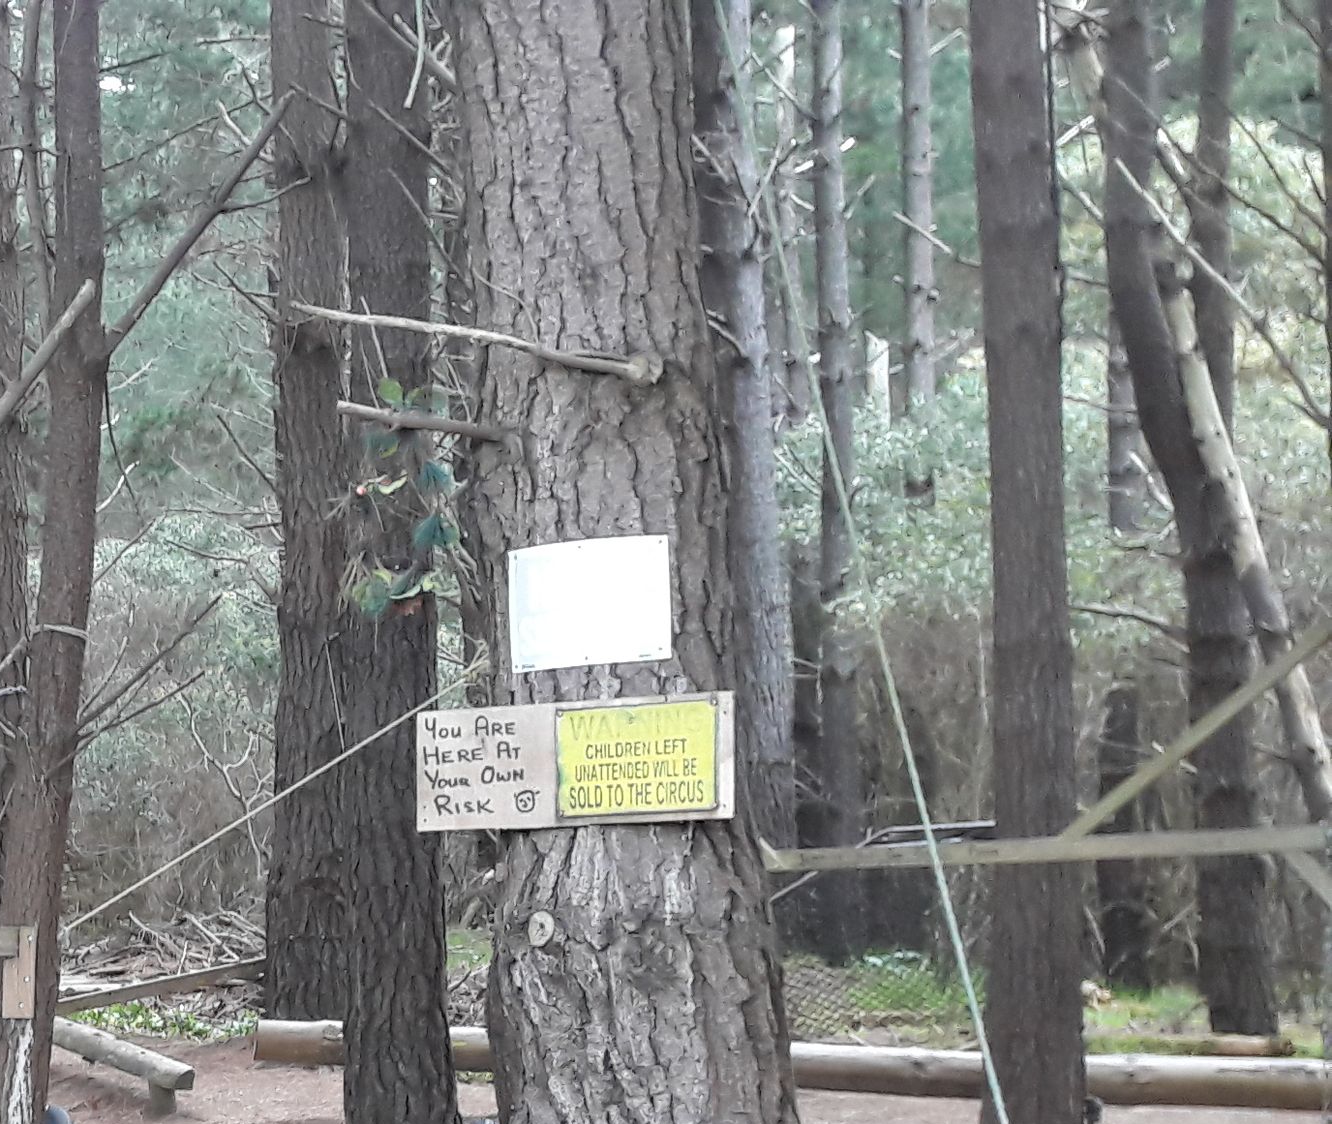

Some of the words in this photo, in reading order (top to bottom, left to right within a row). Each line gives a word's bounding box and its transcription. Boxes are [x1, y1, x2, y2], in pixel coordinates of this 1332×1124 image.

[424, 717, 462, 739] YOU
[475, 715, 516, 737] ARE
[570, 708, 702, 741] WANING
[422, 746, 483, 767] HERE
[496, 741, 521, 760] AT
[586, 741, 651, 760] CHILDREN
[655, 738, 687, 755] LEFT
[424, 766, 471, 789] YOUR
[480, 765, 525, 784] OWN
[575, 761, 649, 782] UNATTENDED
[653, 759, 679, 778] WILL
[683, 758, 697, 776] BE
[434, 794, 495, 816] RISK
[569, 785, 602, 809] SOLD
[607, 784, 624, 807] TO
[628, 782, 652, 806] THE
[656, 780, 704, 804] CIRCUS
